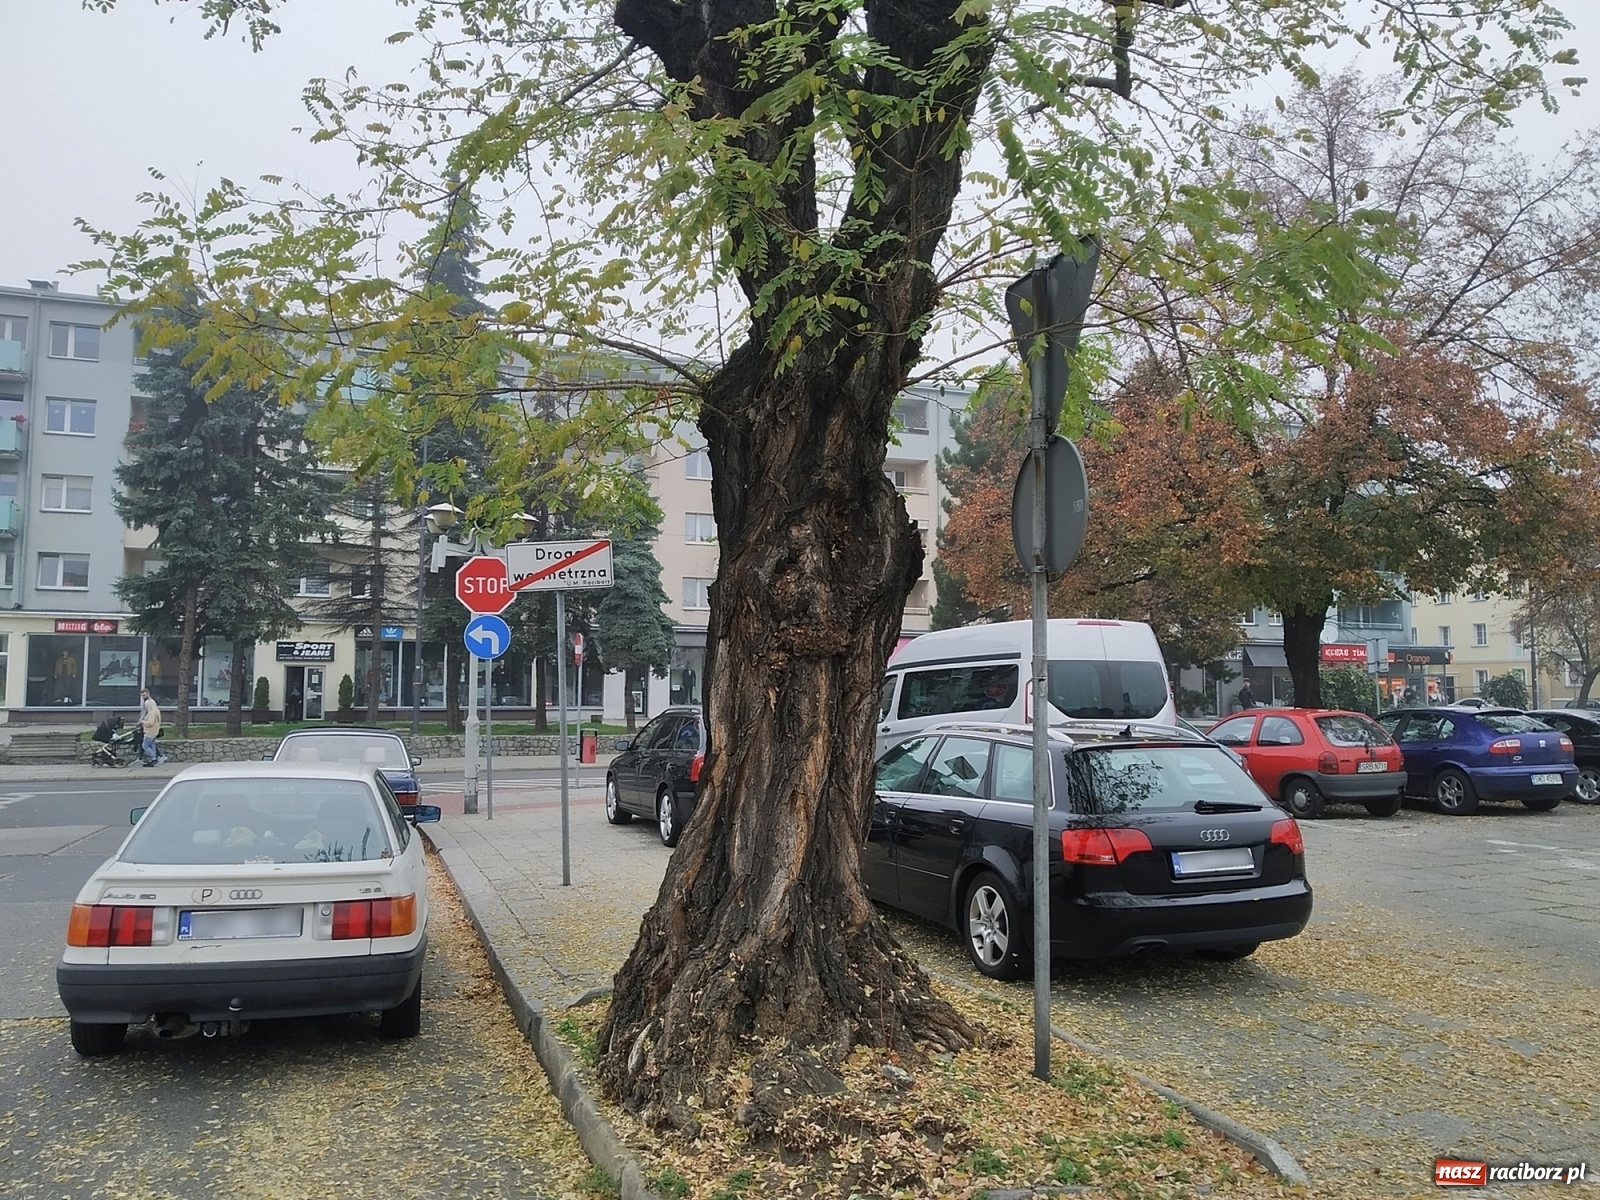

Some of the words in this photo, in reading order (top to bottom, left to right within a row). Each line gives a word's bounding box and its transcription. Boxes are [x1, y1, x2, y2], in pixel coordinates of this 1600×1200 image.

[464, 576, 508, 594] STOP
[1406, 653, 1431, 664] Orange
[201, 889, 213, 902] P
